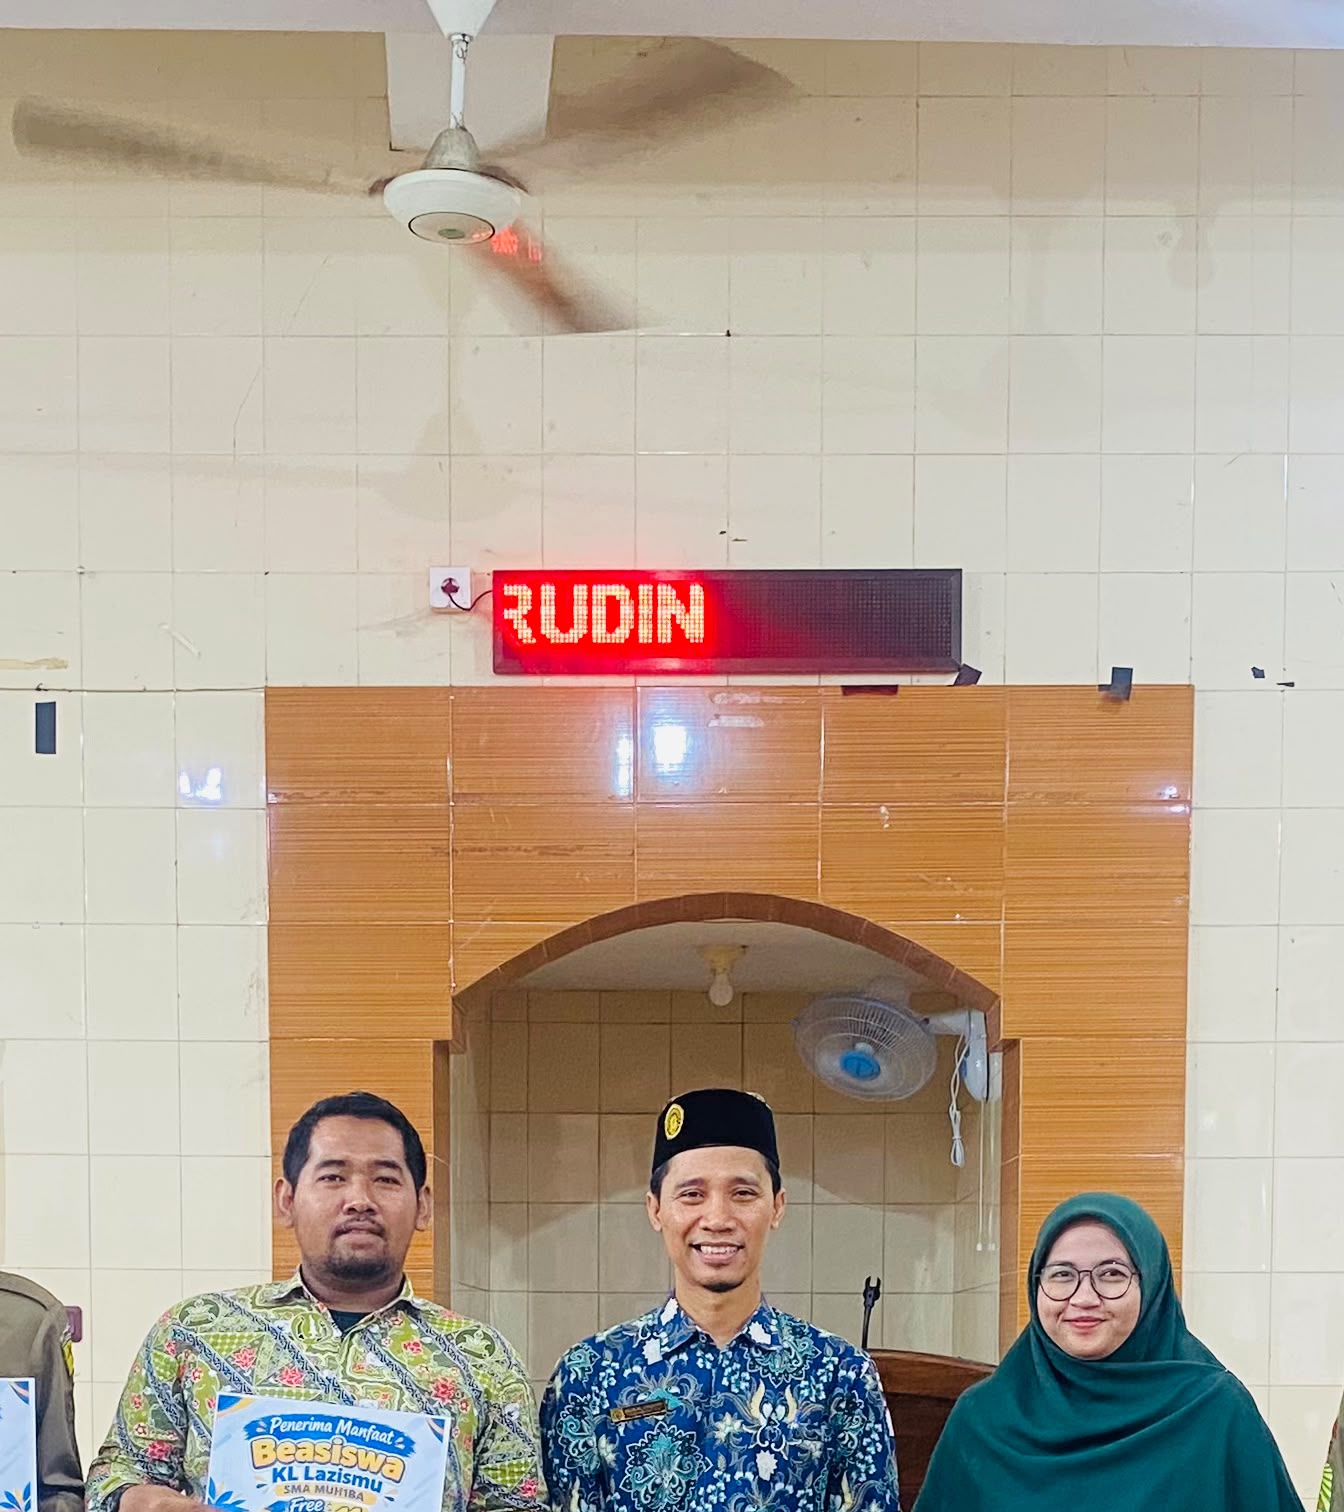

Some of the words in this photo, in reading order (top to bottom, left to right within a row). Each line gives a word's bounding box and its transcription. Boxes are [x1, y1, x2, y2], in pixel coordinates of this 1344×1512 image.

[503, 584, 704, 644] RUDIN
[270, 1417, 333, 1434] Penerima
[336, 1419, 394, 1445] Manfaat
[251, 1437, 405, 1483] Beasiswa
[272, 1466, 301, 1483] KL
[304, 1466, 382, 1493] Lazismu
[283, 1484, 310, 1494] SMA
[289, 1498, 323, 1512] Free
